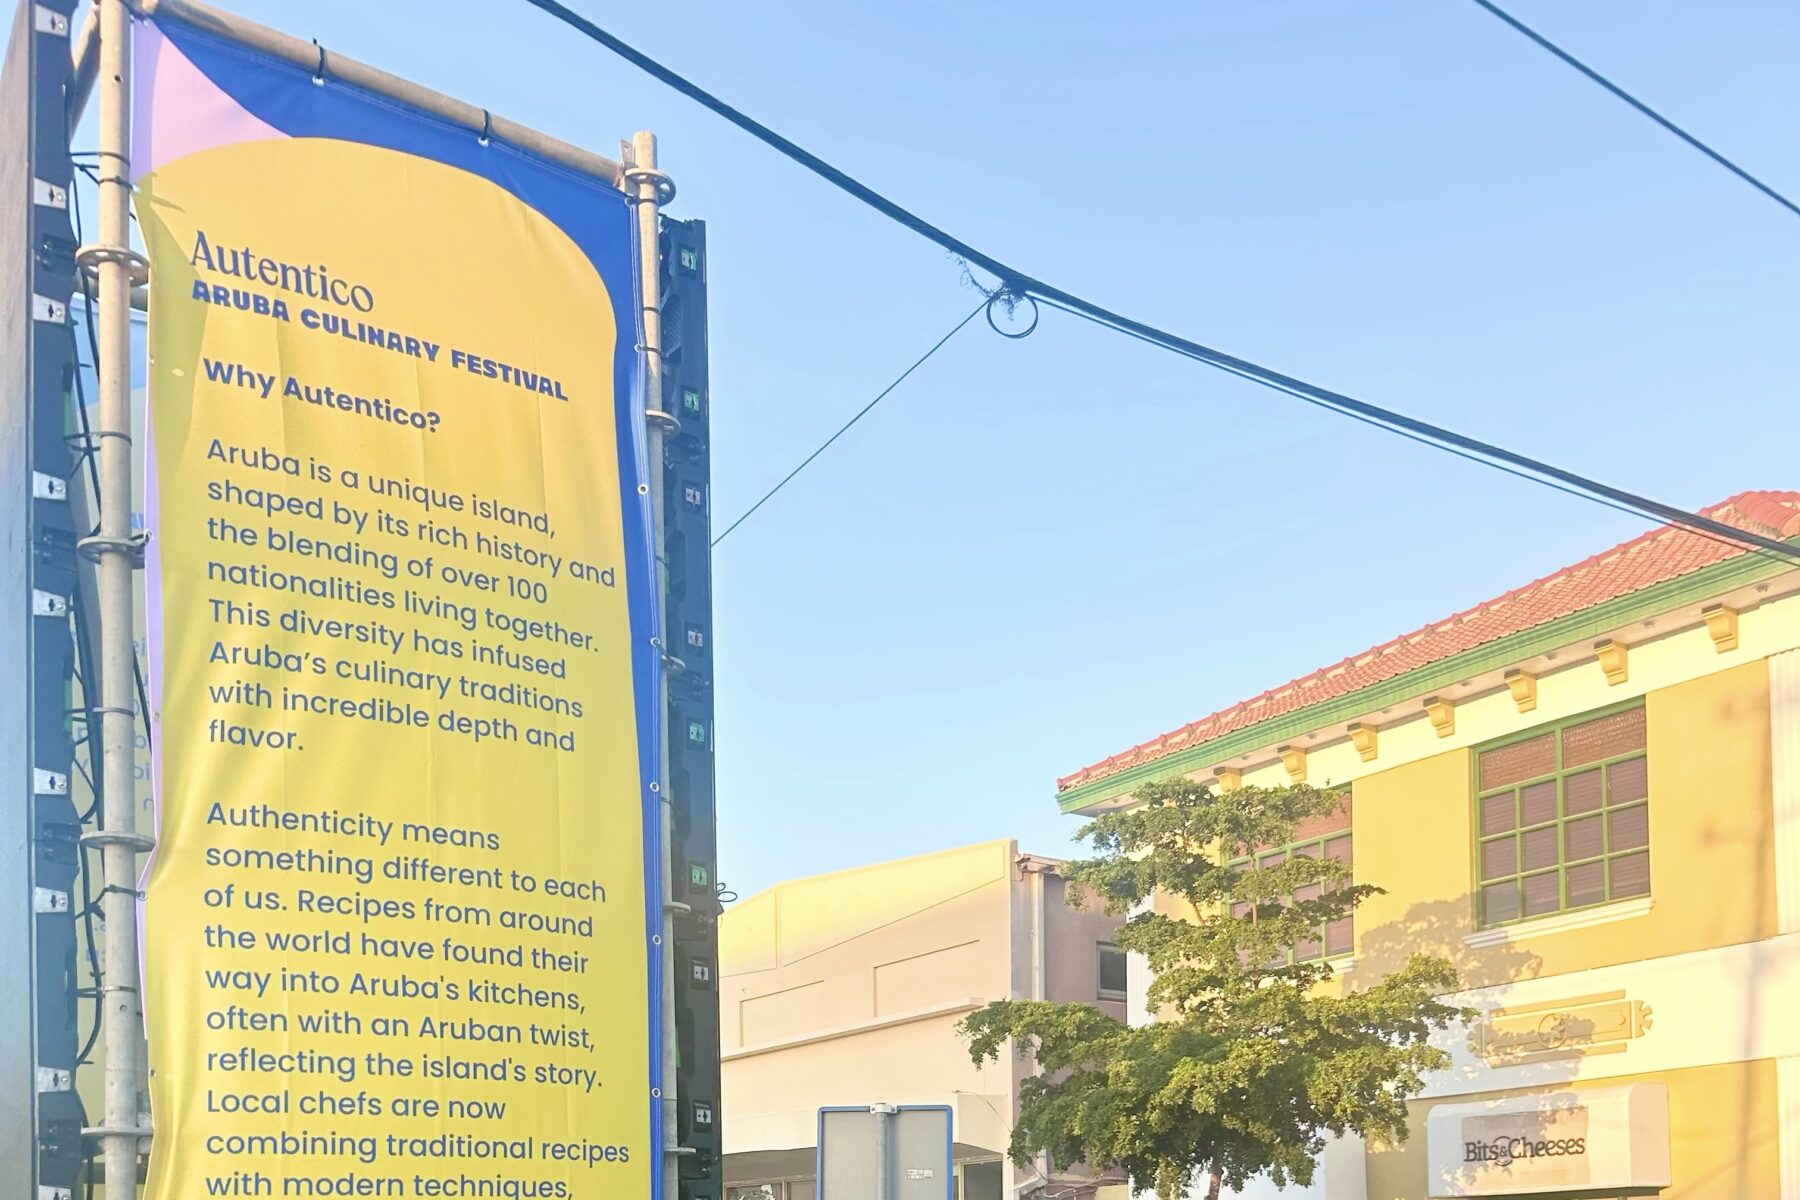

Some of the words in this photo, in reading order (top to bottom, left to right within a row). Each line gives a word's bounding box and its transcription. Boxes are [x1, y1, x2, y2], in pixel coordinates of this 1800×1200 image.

[190, 229, 374, 313] Autentico
[191, 279, 291, 323] ARUBA
[300, 308, 441, 363] CULINARY
[450, 348, 569, 402] FESTIVAL
[203, 357, 276, 400] Why
[282, 376, 441, 434] Autentico?
[207, 438, 300, 477] Aruba
[309, 456, 332, 484] is
[340, 470, 359, 490] a
[368, 475, 465, 512] unique
[471, 493, 555, 540] island,
[207, 479, 324, 521] shaped
[333, 500, 369, 535] by
[377, 508, 409, 537] its
[418, 519, 468, 551] rich
[476, 531, 563, 579] history
[569, 560, 615, 589] and
[207, 517, 258, 547] the
[267, 526, 398, 580] blending
[407, 556, 434, 580] of
[441, 566, 500, 593] over
[507, 575, 548, 604] 100
[208, 561, 396, 609] nationalities
[404, 589, 477, 632] living
[484, 607, 599, 653] together.
[208, 598, 271, 628] This
[279, 609, 405, 655] diversity
[413, 628, 464, 659] has
[471, 639, 566, 680] infused
[208, 679, 272, 709] with
[282, 686, 430, 728] incredible
[437, 709, 518, 743] depth
[525, 728, 575, 753] and
[335, 660, 452, 700] culinary
[458, 675, 583, 718] traditions
[208, 718, 304, 751] flavor.
[206, 801, 394, 847] Authenticity
[402, 823, 500, 851] means
[205, 847, 373, 885] something
[382, 856, 503, 890] different
[510, 869, 537, 893] to
[543, 878, 606, 903] each
[203, 883, 235, 908] of
[244, 890, 288, 911] us.
[298, 889, 416, 924] Recipes
[423, 897, 491, 927] from
[499, 910, 593, 938] around
[203, 924, 257, 950] the
[264, 929, 351, 955] world
[361, 932, 435, 960] have
[442, 937, 523, 968] found
[530, 947, 589, 974] their
[205, 970, 272, 999] way
[281, 966, 340, 994] into
[348, 972, 460, 1001] Aruba's
[468, 978, 586, 1015] kitchens,
[206, 1004, 288, 1032] often
[297, 1008, 362, 1035] with
[370, 1017, 409, 1037] an
[418, 1016, 522, 1044] Aruban
[529, 1023, 595, 1053] twist,
[207, 1046, 356, 1083] reflecting
[364, 1052, 414, 1077] the
[422, 1053, 527, 1083] island's
[534, 1062, 603, 1094] story.
[207, 1089, 289, 1114] Local
[298, 1090, 382, 1116] chefs
[391, 1098, 440, 1118] are
[448, 1100, 507, 1120] now
[206, 1129, 377, 1164] combining
[386, 1133, 533, 1160] traditional
[542, 1138, 630, 1169] recipes
[205, 1170, 272, 1197] with
[283, 1172, 404, 1197] modern
